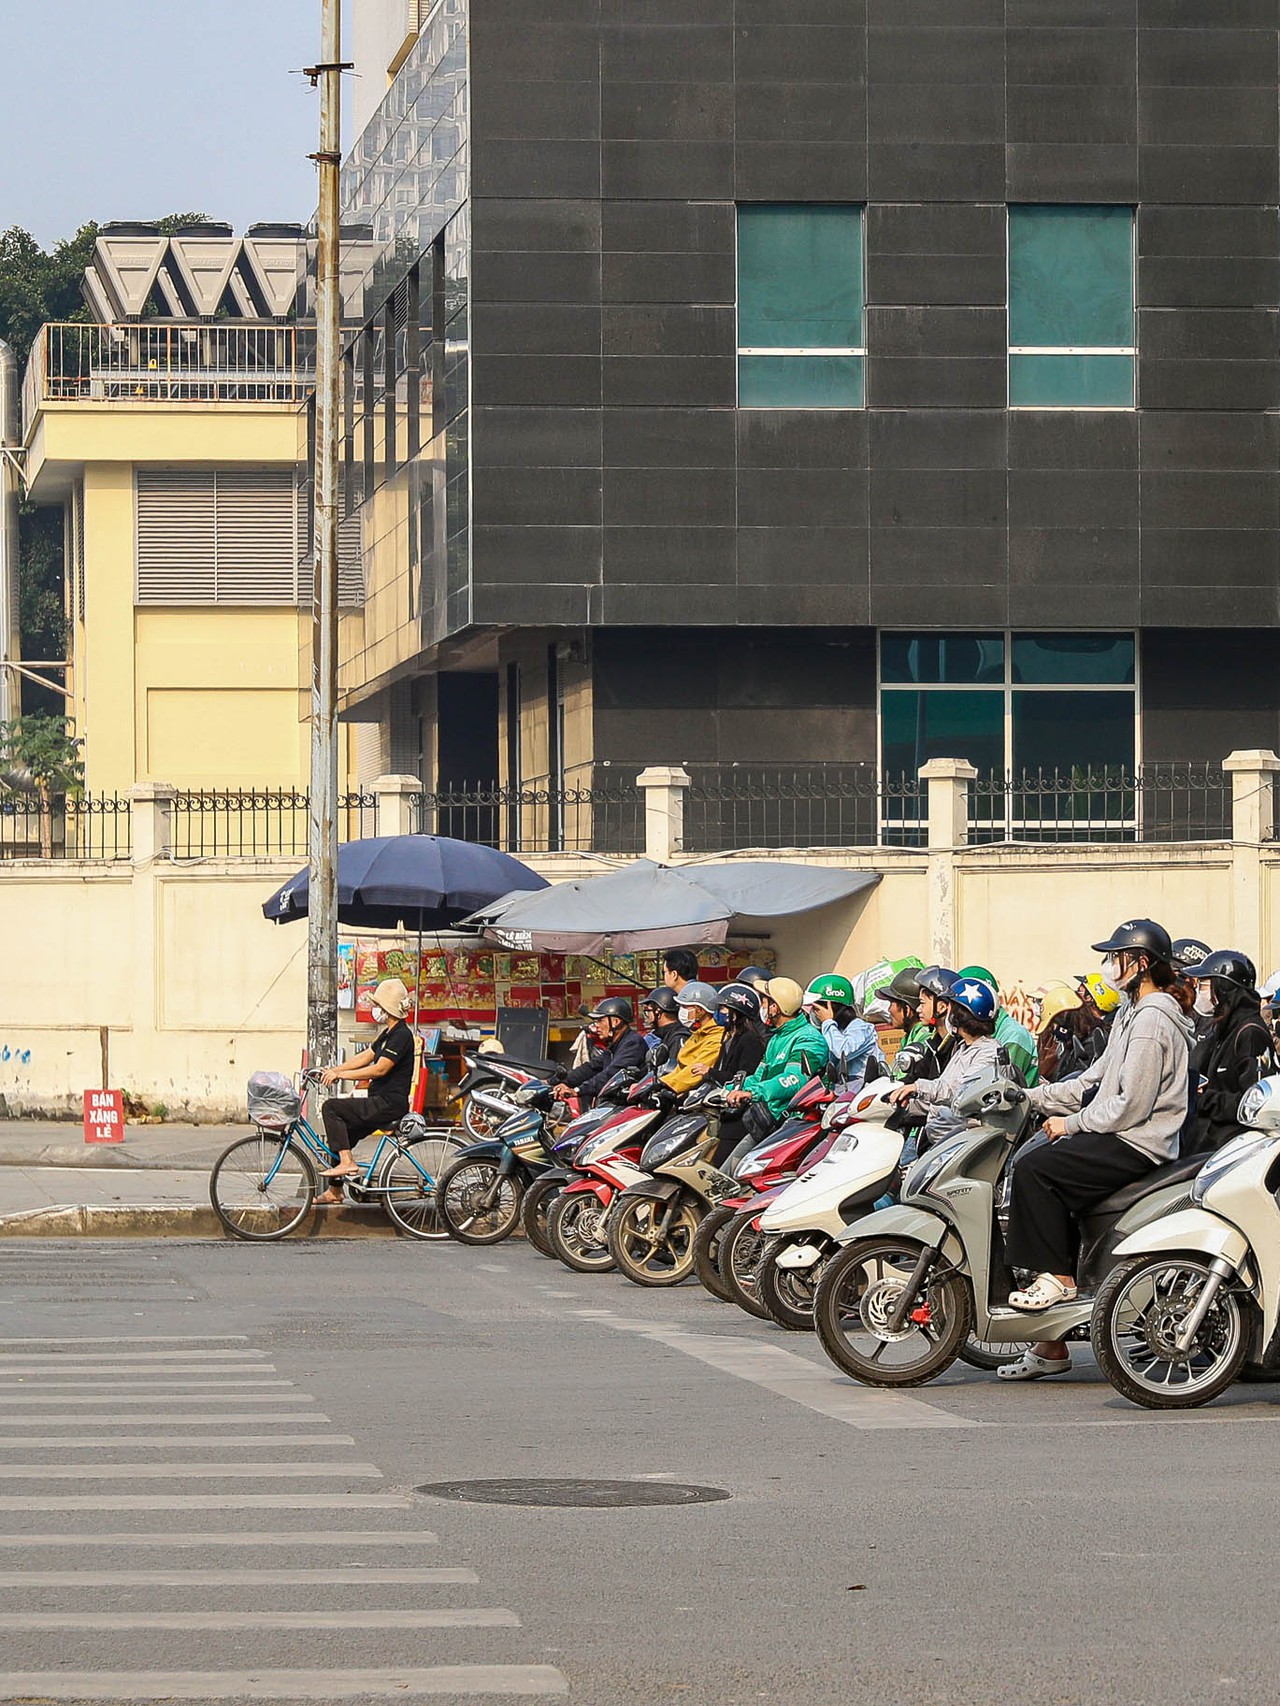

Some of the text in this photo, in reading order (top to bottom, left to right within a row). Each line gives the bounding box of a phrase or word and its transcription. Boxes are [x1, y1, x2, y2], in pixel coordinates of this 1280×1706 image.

[825, 986, 845, 997] Grab
[778, 1074, 800, 1088] Gra
[91, 1093, 114, 1107] BÁN
[89, 1110, 118, 1123] XĂNG
[96, 1124, 112, 1138] LẺ
